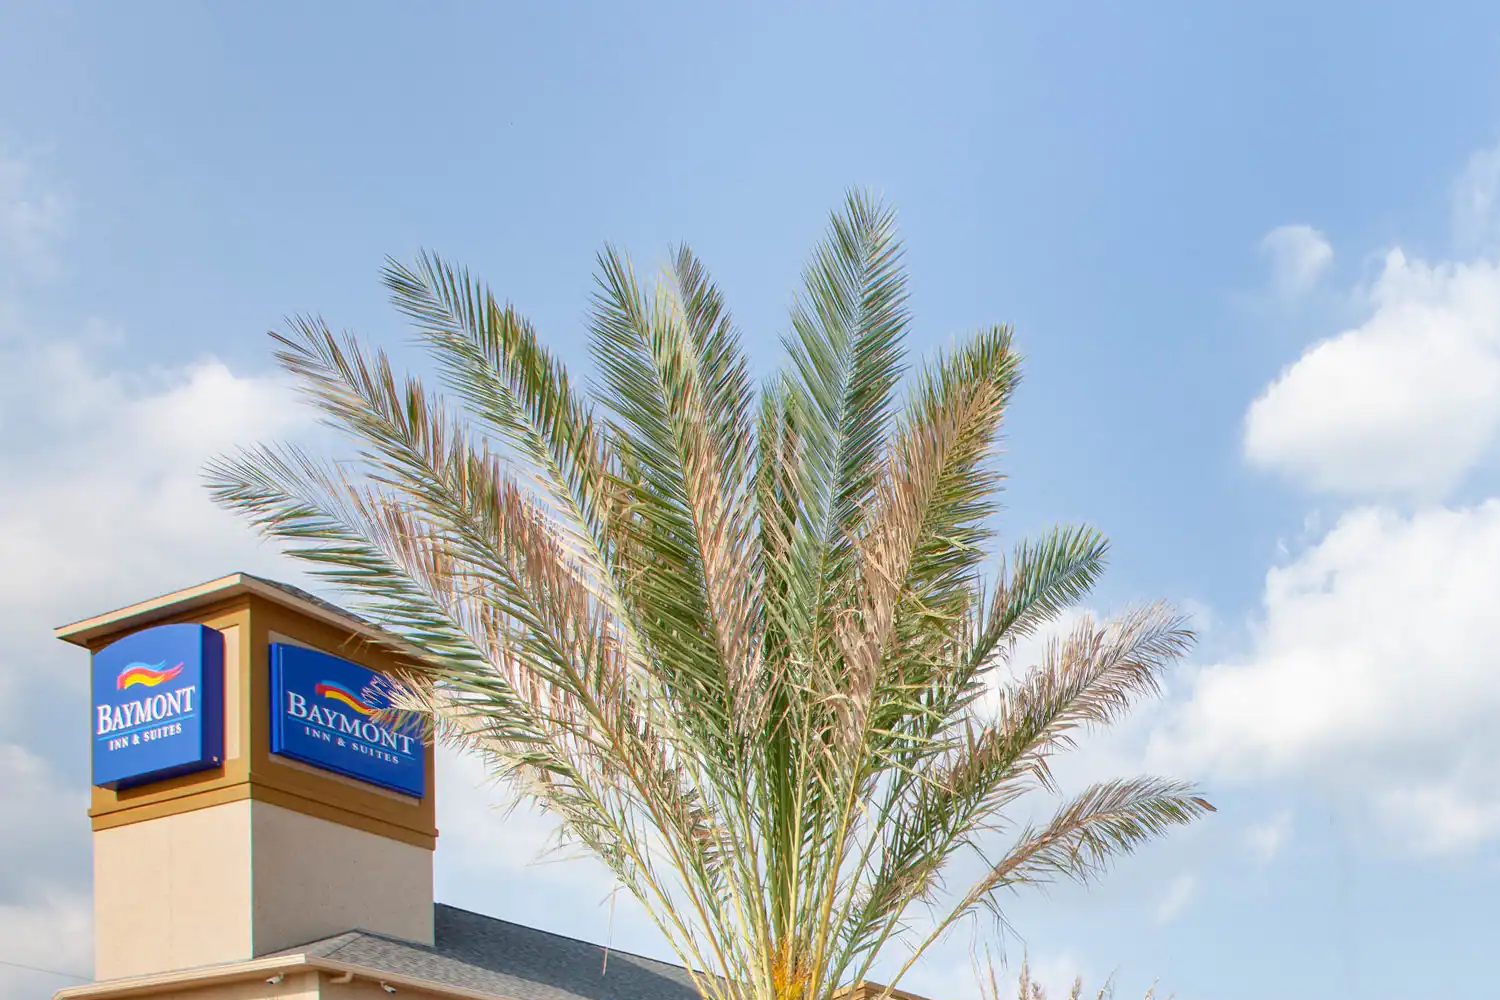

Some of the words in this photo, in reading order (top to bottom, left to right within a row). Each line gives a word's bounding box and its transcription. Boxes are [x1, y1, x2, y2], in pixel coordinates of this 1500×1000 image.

[97, 685, 196, 735] BAYMONT
[287, 690, 415, 754] BAYMONT
[109, 736, 128, 751] INN
[132, 734, 140, 745] &
[143, 723, 182, 742] SUITES
[304, 726, 331, 743] INN
[337, 737, 346, 747] &
[351, 742, 400, 765] SUITES
